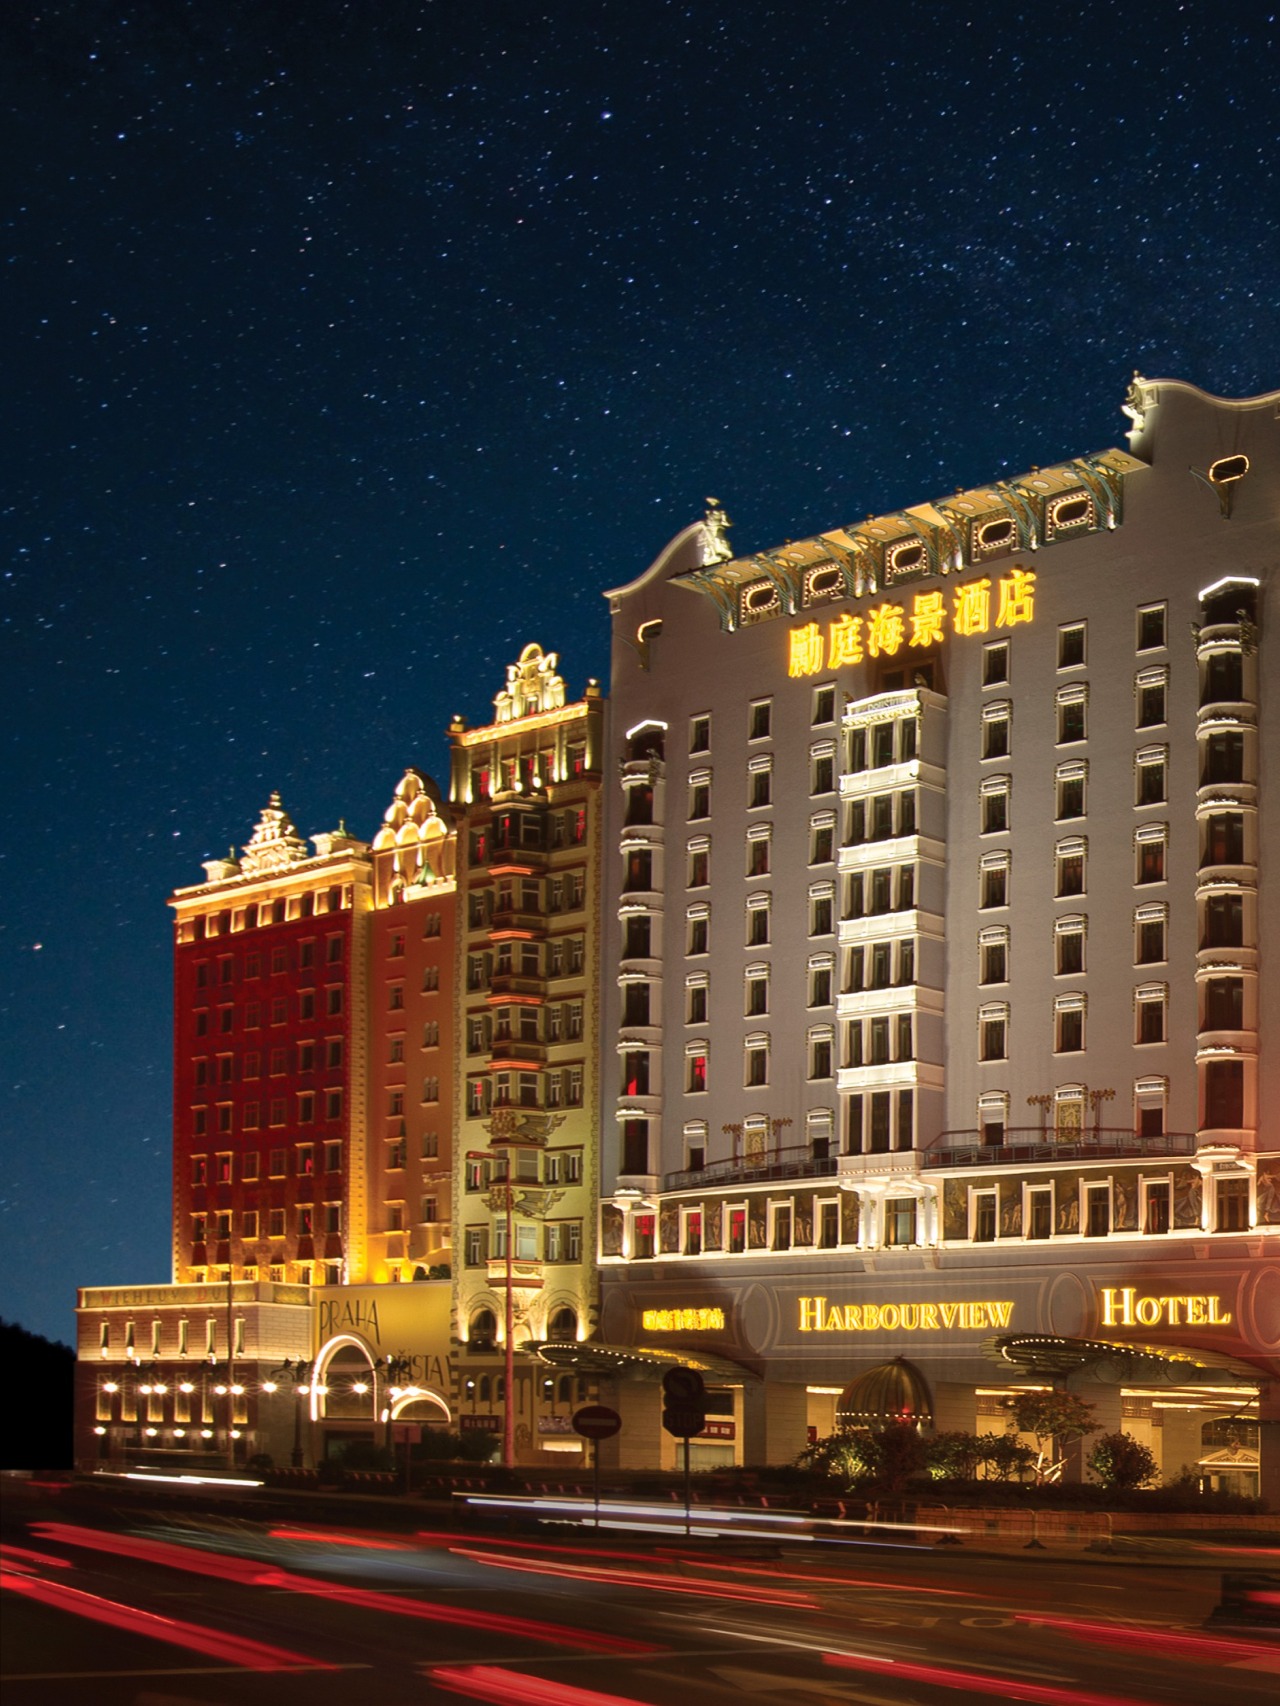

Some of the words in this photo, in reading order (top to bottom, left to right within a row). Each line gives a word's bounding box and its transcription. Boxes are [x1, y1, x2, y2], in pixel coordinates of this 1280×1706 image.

[788, 569, 1037, 678] 勵庭海景酒店
[319, 1299, 381, 1348] PRAHA
[798, 1297, 1015, 1331] HARBOURVIEW
[1101, 1287, 1232, 1326] HOTEL
